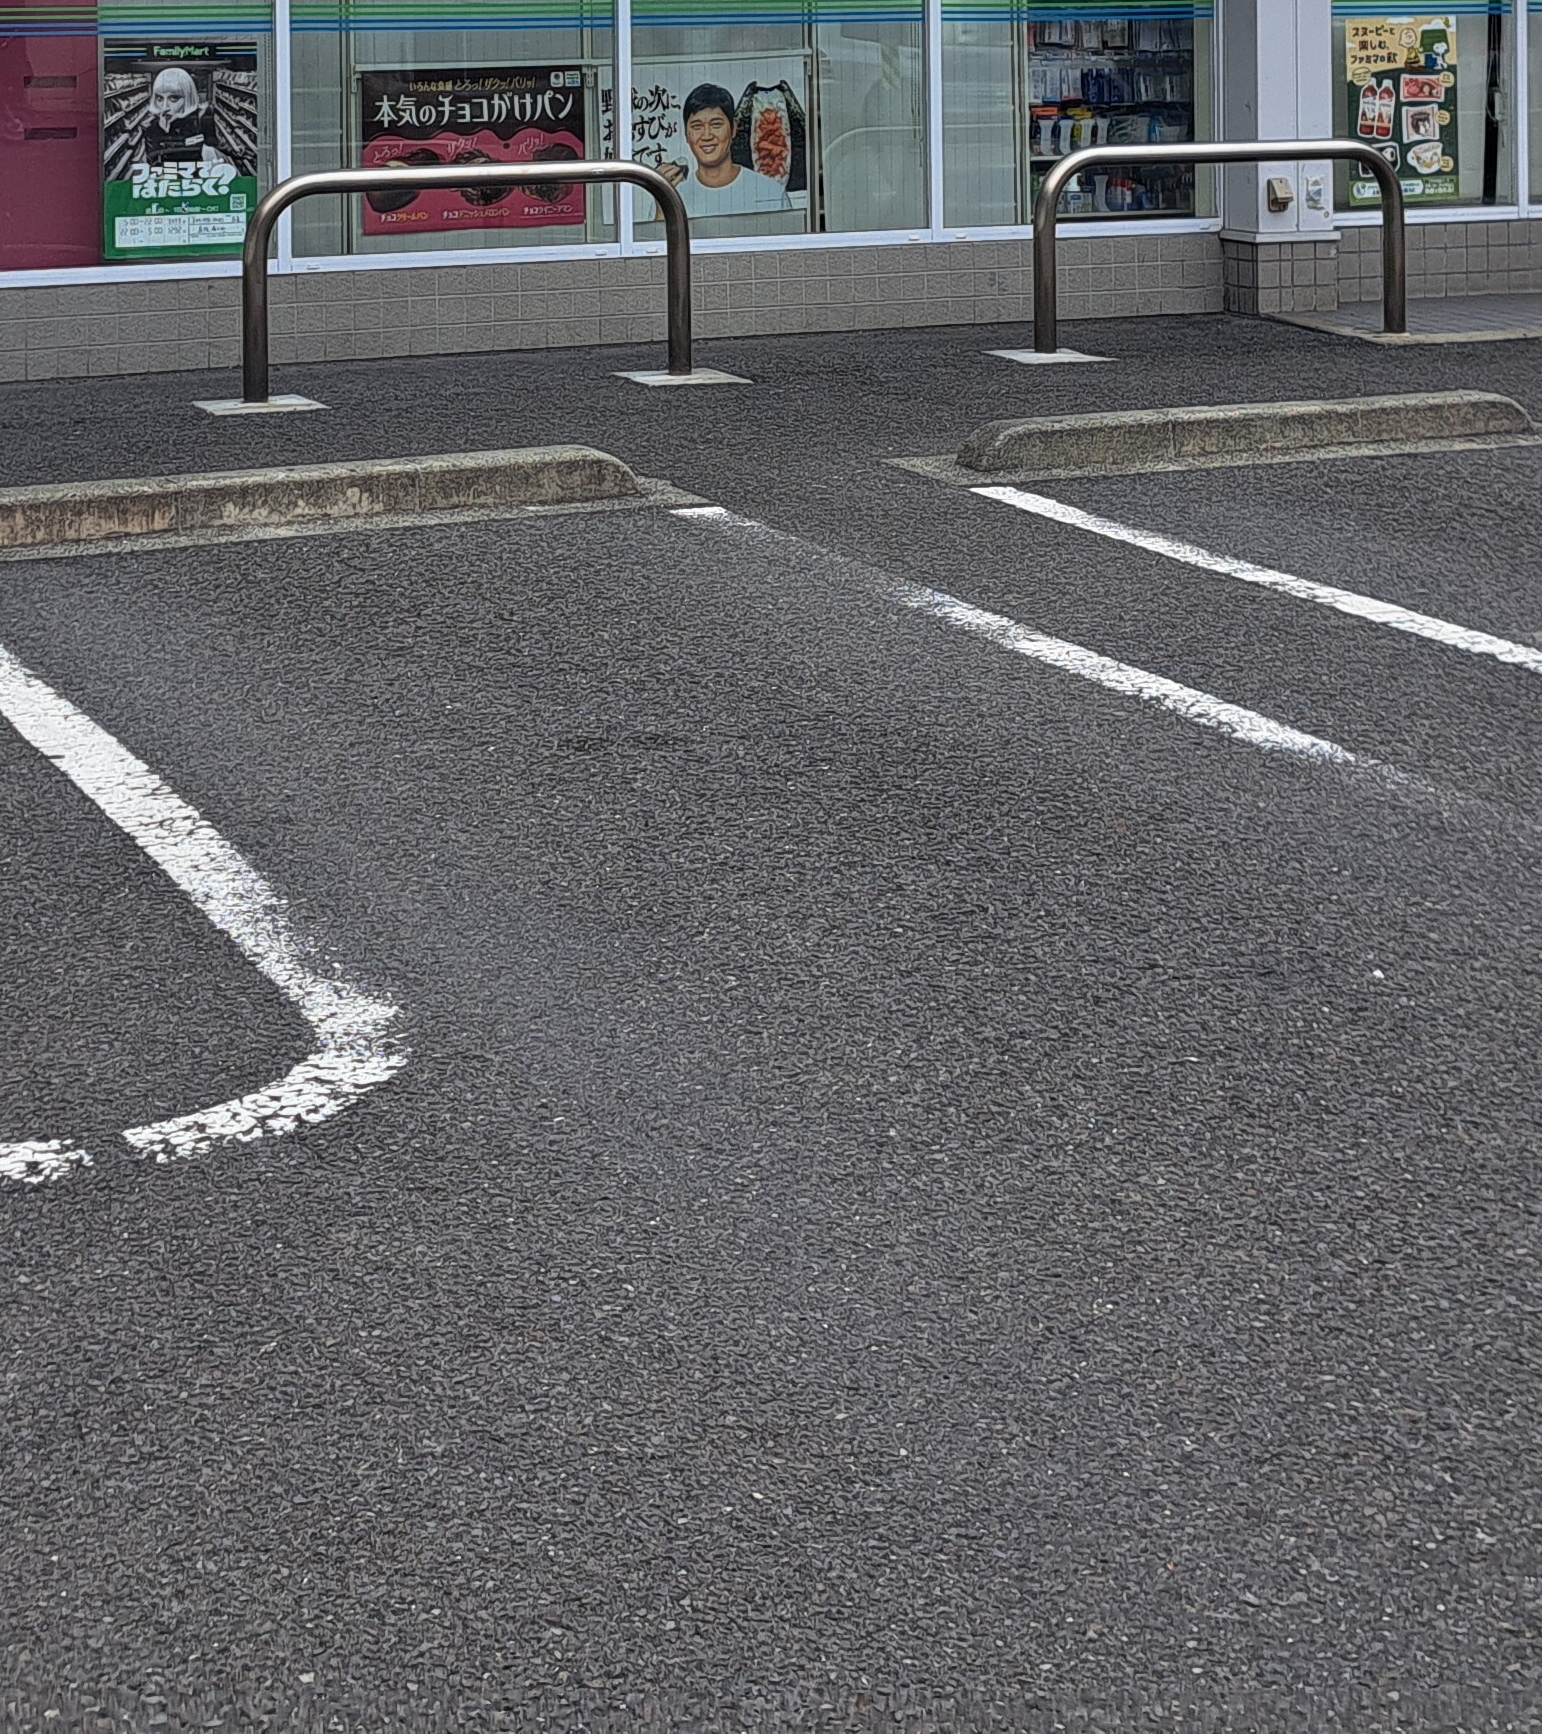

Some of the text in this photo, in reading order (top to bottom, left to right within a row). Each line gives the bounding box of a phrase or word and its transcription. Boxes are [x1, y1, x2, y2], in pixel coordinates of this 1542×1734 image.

[1352, 24, 1396, 37] スヌーピーと
[153, 46, 209, 58] FamilyMart
[373, 92, 573, 128] 本気のチョコがけパン
